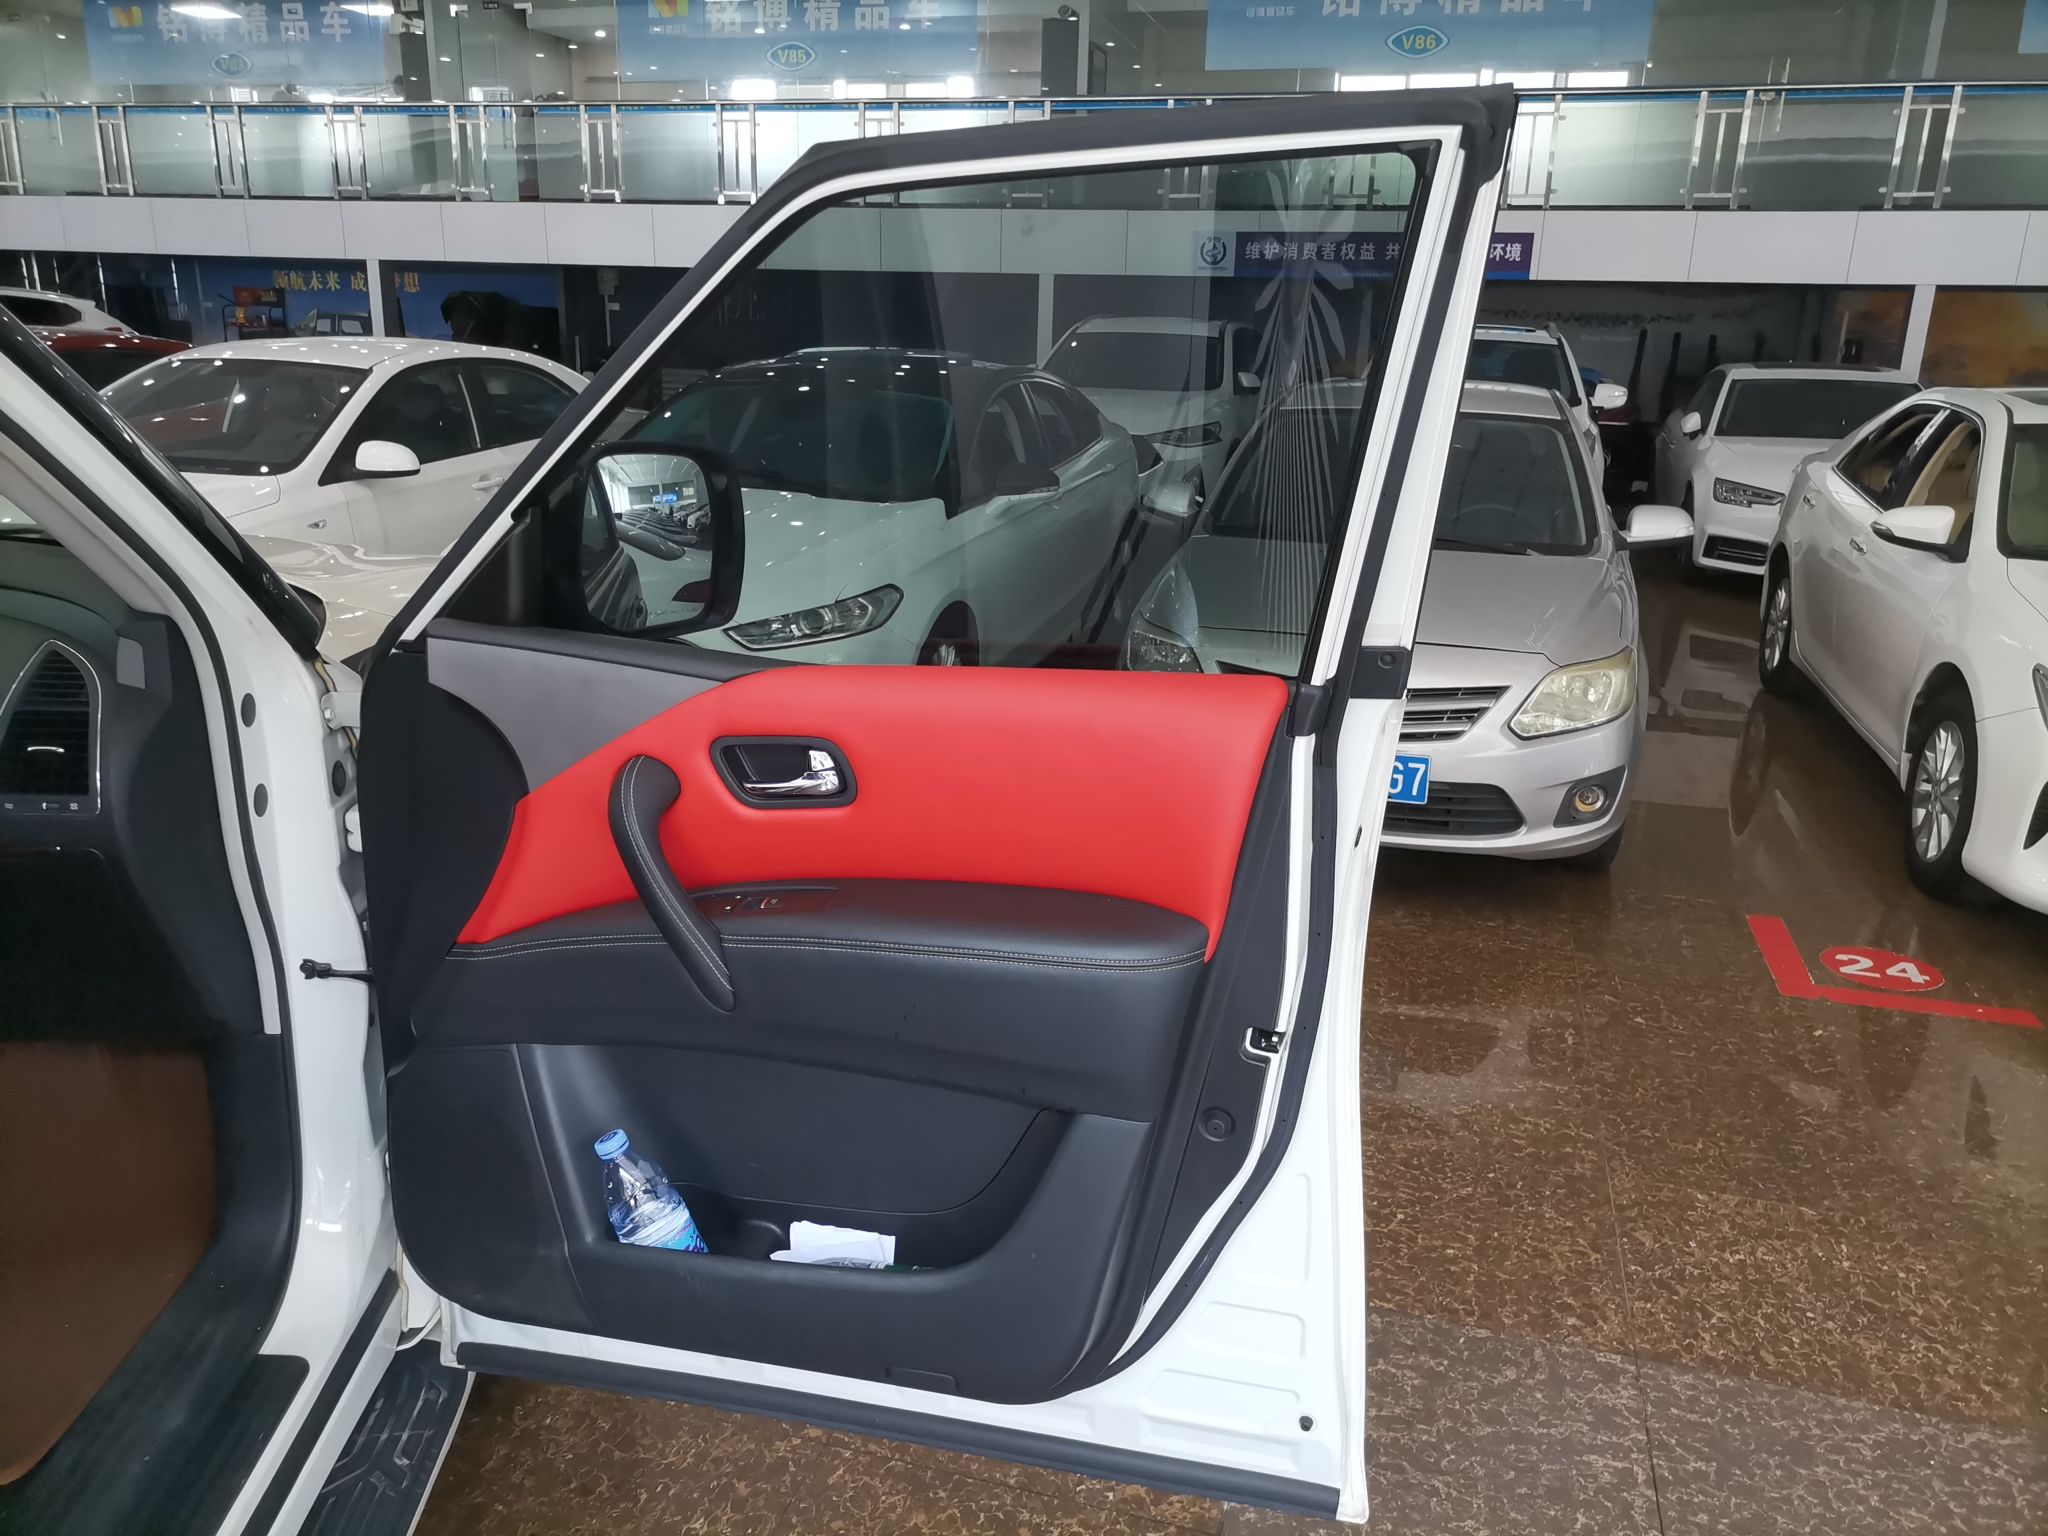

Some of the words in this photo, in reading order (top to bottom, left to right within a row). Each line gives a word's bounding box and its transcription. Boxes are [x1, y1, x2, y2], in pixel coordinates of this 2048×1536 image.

[1402, 34, 1436, 50] V86
[778, 49, 806, 64] V85
[1245, 241, 1375, 261] 维护消费者权益
[1490, 243, 1522, 262] 环境
[1834, 954, 1930, 984] 24
